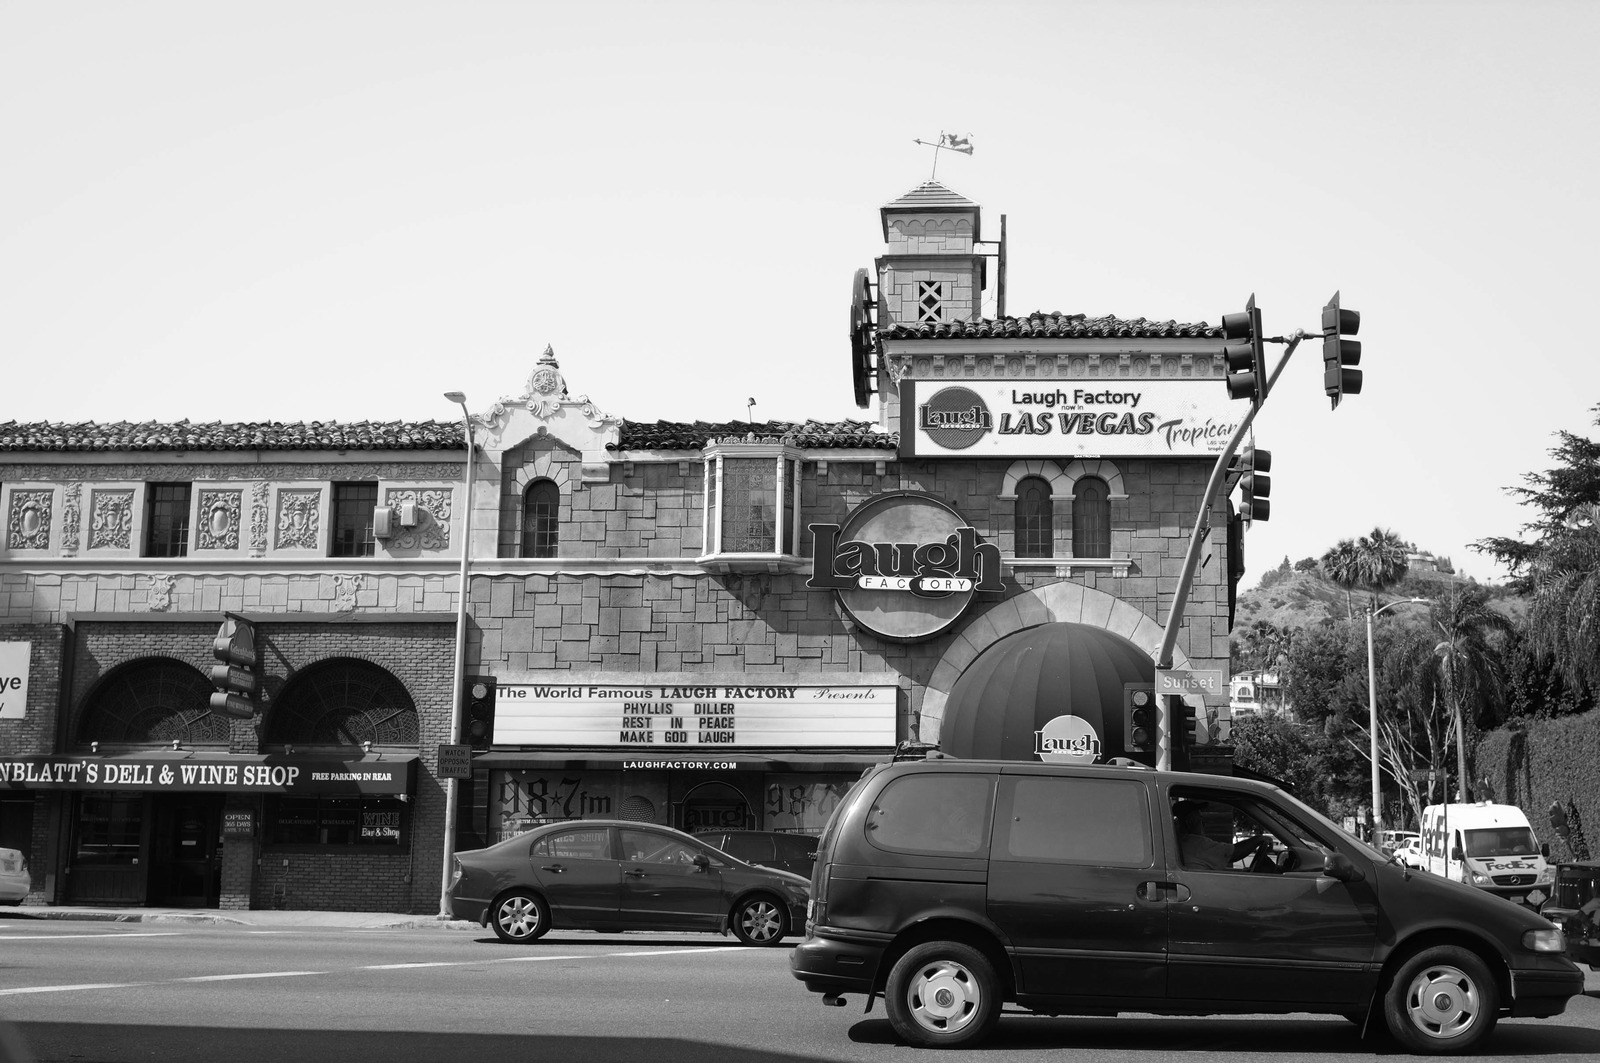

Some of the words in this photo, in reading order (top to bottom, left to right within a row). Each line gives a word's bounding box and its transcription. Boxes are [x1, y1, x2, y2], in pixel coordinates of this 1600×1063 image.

[1012, 388, 1067, 408] Laugh
[1074, 389, 1141, 408] Factory
[919, 404, 993, 432] Laugh
[998, 412, 1052, 436] LAS
[1057, 411, 1155, 437] VEGAS
[805, 523, 1007, 599] Laugh
[1163, 676, 1214, 689] Sunset
[498, 688, 527, 698] The
[534, 688, 582, 698] World
[588, 688, 653, 699] Famous
[660, 688, 717, 699] LAUGH
[724, 688, 797, 699] FACTORY
[813, 688, 878, 700] Presents
[623, 702, 673, 715] PHYLLIS
[693, 703, 735, 715] DILLER
[622, 717, 652, 729] REST
[670, 717, 683, 729] IN
[699, 717, 735, 729] PEACE
[619, 731, 653, 743] MAKE
[664, 731, 687, 743] GOD
[698, 731, 735, 743] LAUGH
[1034, 731, 1102, 757] Laugh
[623, 761, 737, 769] LAUGHFACTORY.COM
[103, 765, 154, 785] DELI
[158, 764, 174, 785] &
[180, 765, 238, 785] WINE
[243, 766, 300, 786] SHOP
[311, 773, 330, 781] FREE
[330, 773, 362, 781] PARKING
[362, 773, 372, 781] IN
[372, 773, 392, 781] REAR
[363, 812, 400, 826] WINE
[361, 827, 374, 837] Bar
[375, 827, 382, 837] &
[382, 827, 400, 839] Shop
[1420, 814, 1450, 858] FedEx
[1485, 861, 1537, 871] FedEx
